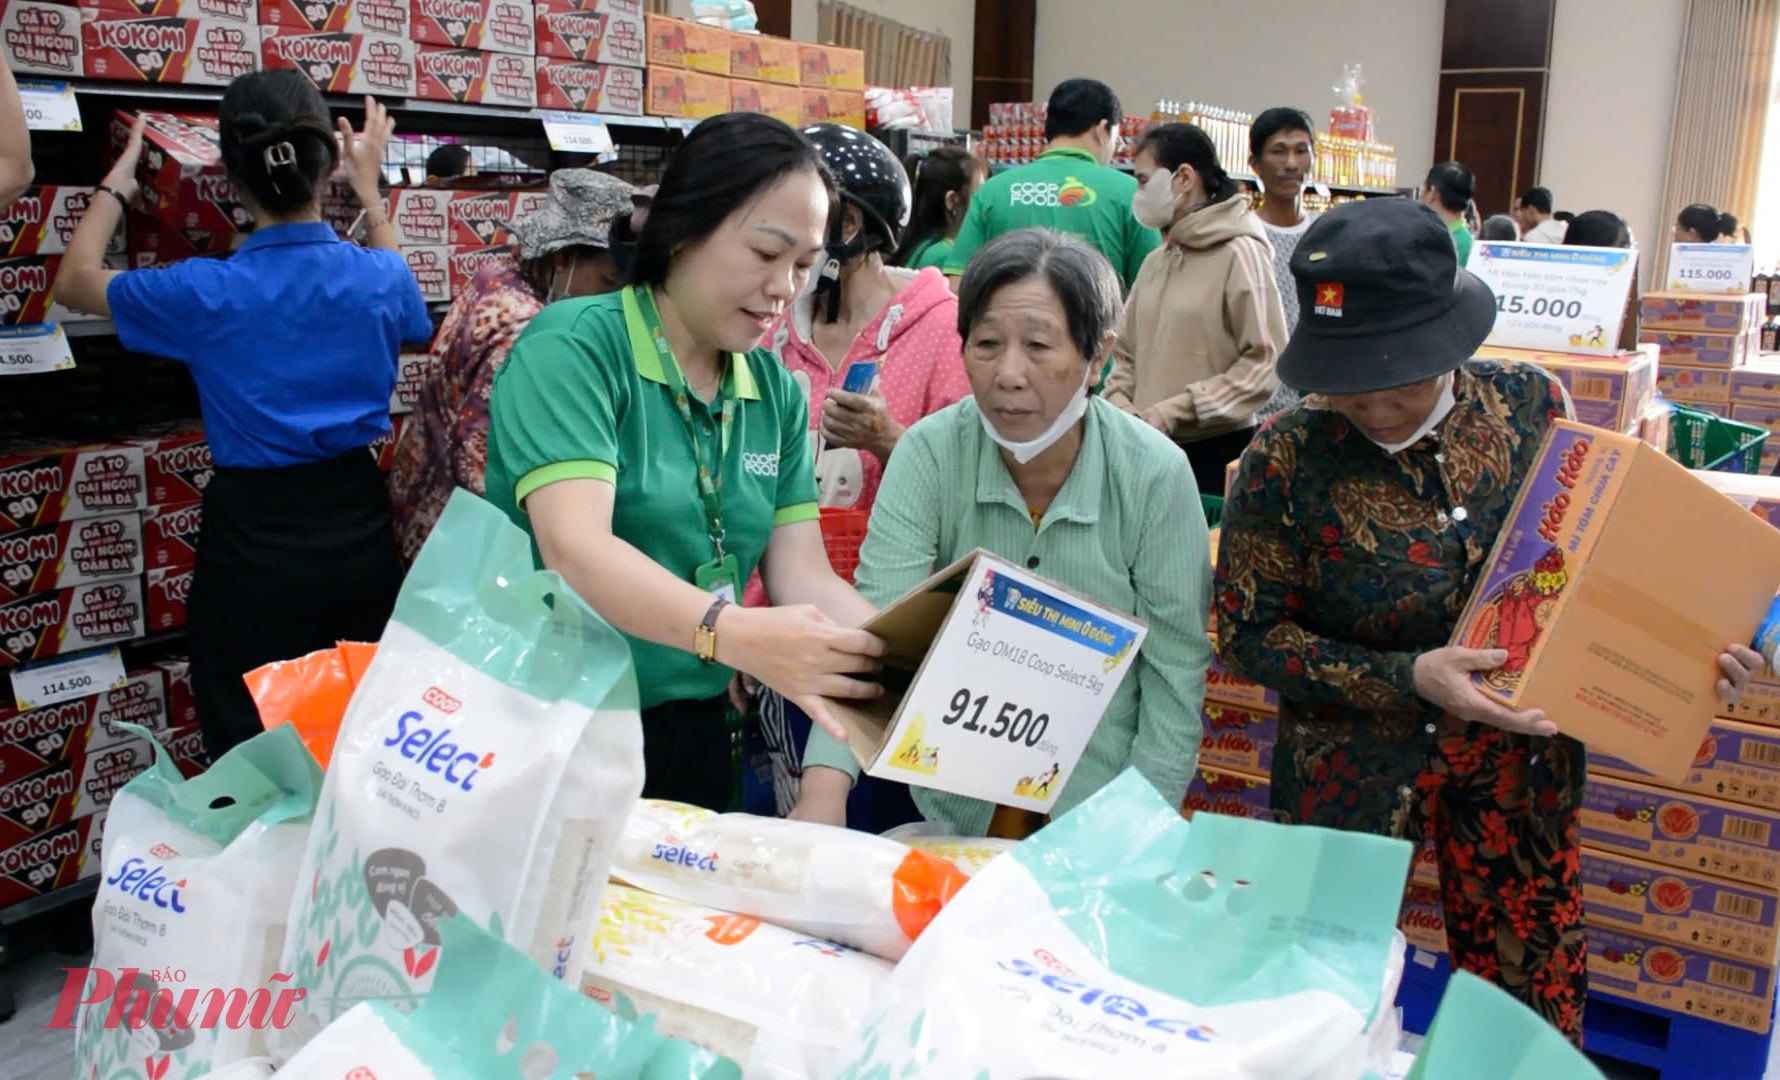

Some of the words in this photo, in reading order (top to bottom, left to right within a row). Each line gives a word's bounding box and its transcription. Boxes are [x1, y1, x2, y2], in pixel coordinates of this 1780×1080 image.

[41, 12, 61, 26] TO
[305, 5, 328, 22] 90
[421, 0, 482, 24] KOKOMI
[550, 15, 600, 36] KOKOMI
[34, 34, 74, 51] NGON
[100, 22, 186, 52] KOKOMI
[277, 38, 352, 64] KOKOMI
[136, 52, 164, 72] 90
[310, 64, 333, 81] 90
[422, 54, 483, 77] KOKOMI
[448, 77, 468, 94] 90
[550, 68, 600, 90] KOKOMI
[1011, 182, 1059, 194] COOP
[1010, 193, 1058, 207] FOOD
[453, 200, 510, 222] KOKOMI
[1678, 268, 1733, 280] 115.000
[107, 457, 125, 470] TO
[743, 452, 777, 464] COOP
[744, 461, 778, 477] FOOD
[101, 477, 137, 491] NGON
[8, 497, 38, 519] 90
[103, 521, 120, 535] TO
[98, 542, 133, 557] NGON
[4, 564, 34, 586] 90
[104, 587, 121, 599] TO
[99, 606, 135, 620] NGON
[1017, 597, 1043, 617] SIÊU
[1059, 613, 1084, 633] MINI
[7, 631, 37, 654] 90
[966, 631, 990, 655] Gạo
[991, 640, 1028, 666] OM18
[1026, 653, 1055, 679] Coop
[1054, 663, 1088, 688] Select
[1085, 674, 1105, 696] 5kg
[42, 675, 93, 697] 114.500
[0, 702, 86, 742] KOKOMI
[942, 687, 1050, 749] 91.500
[36, 733, 64, 755] 90
[384, 711, 495, 792] Select
[21, 803, 50, 825] 90
[436, 797, 448, 814] 8
[652, 842, 719, 872] Select
[28, 863, 57, 886] 90
[107, 857, 188, 914] Select
[158, 923, 167, 937] 8
